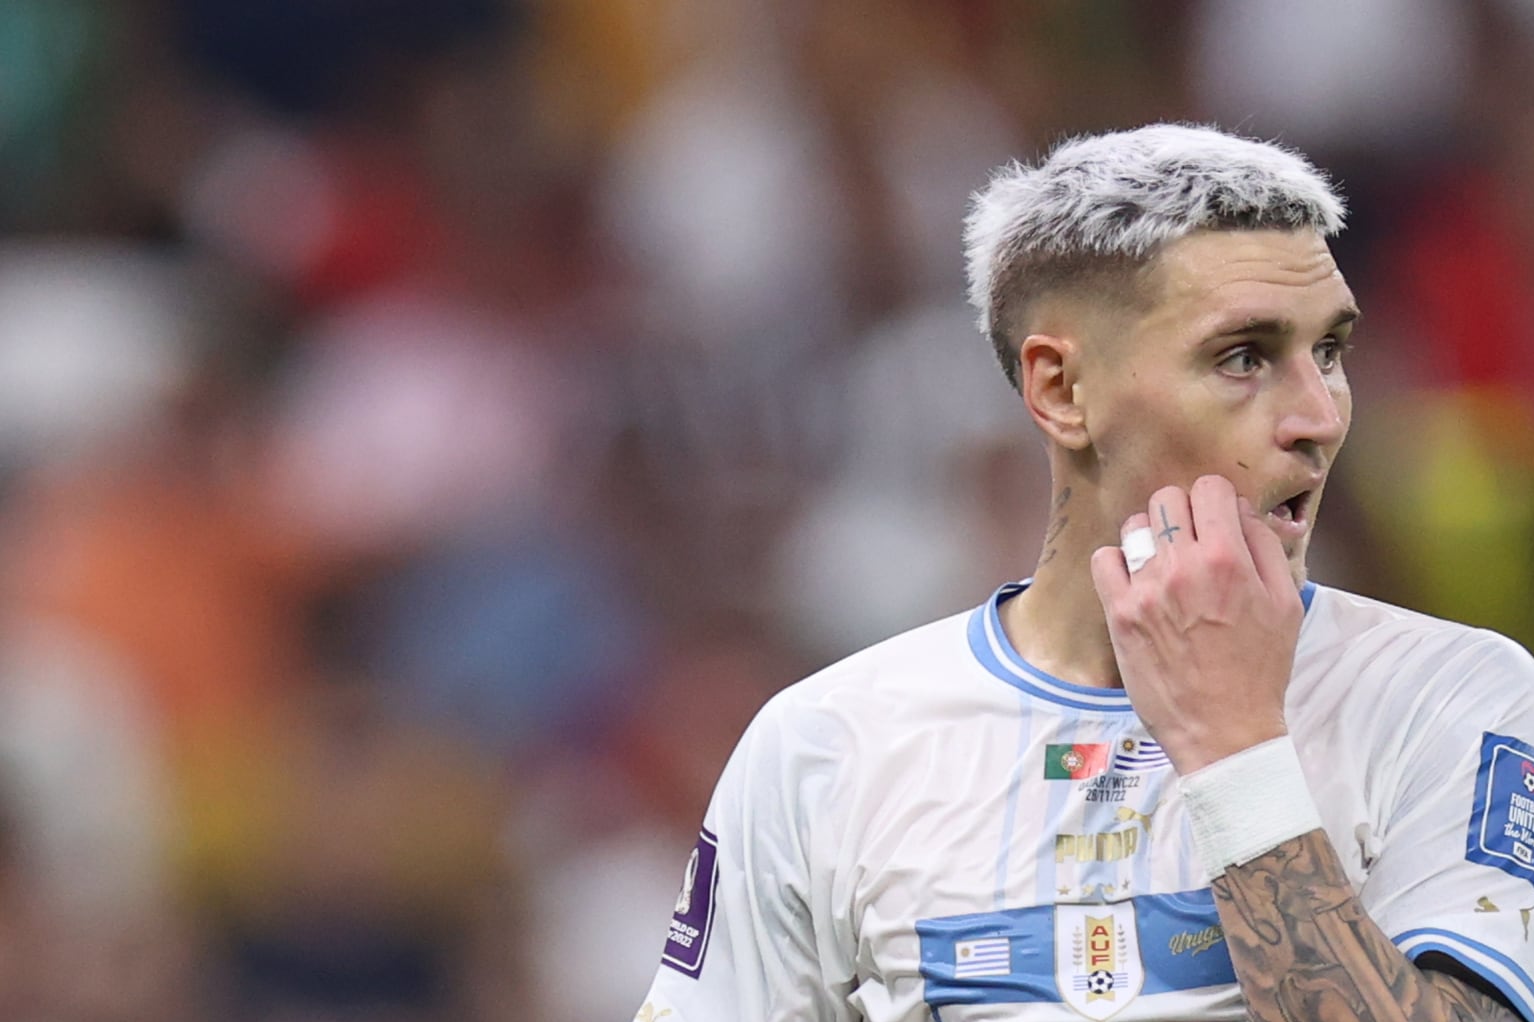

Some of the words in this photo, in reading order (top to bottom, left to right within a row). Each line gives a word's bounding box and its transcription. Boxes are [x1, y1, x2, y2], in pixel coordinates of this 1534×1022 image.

[1504, 823, 1520, 838] the
[686, 925, 700, 938] CUP
[1090, 925, 1110, 966] AUF
